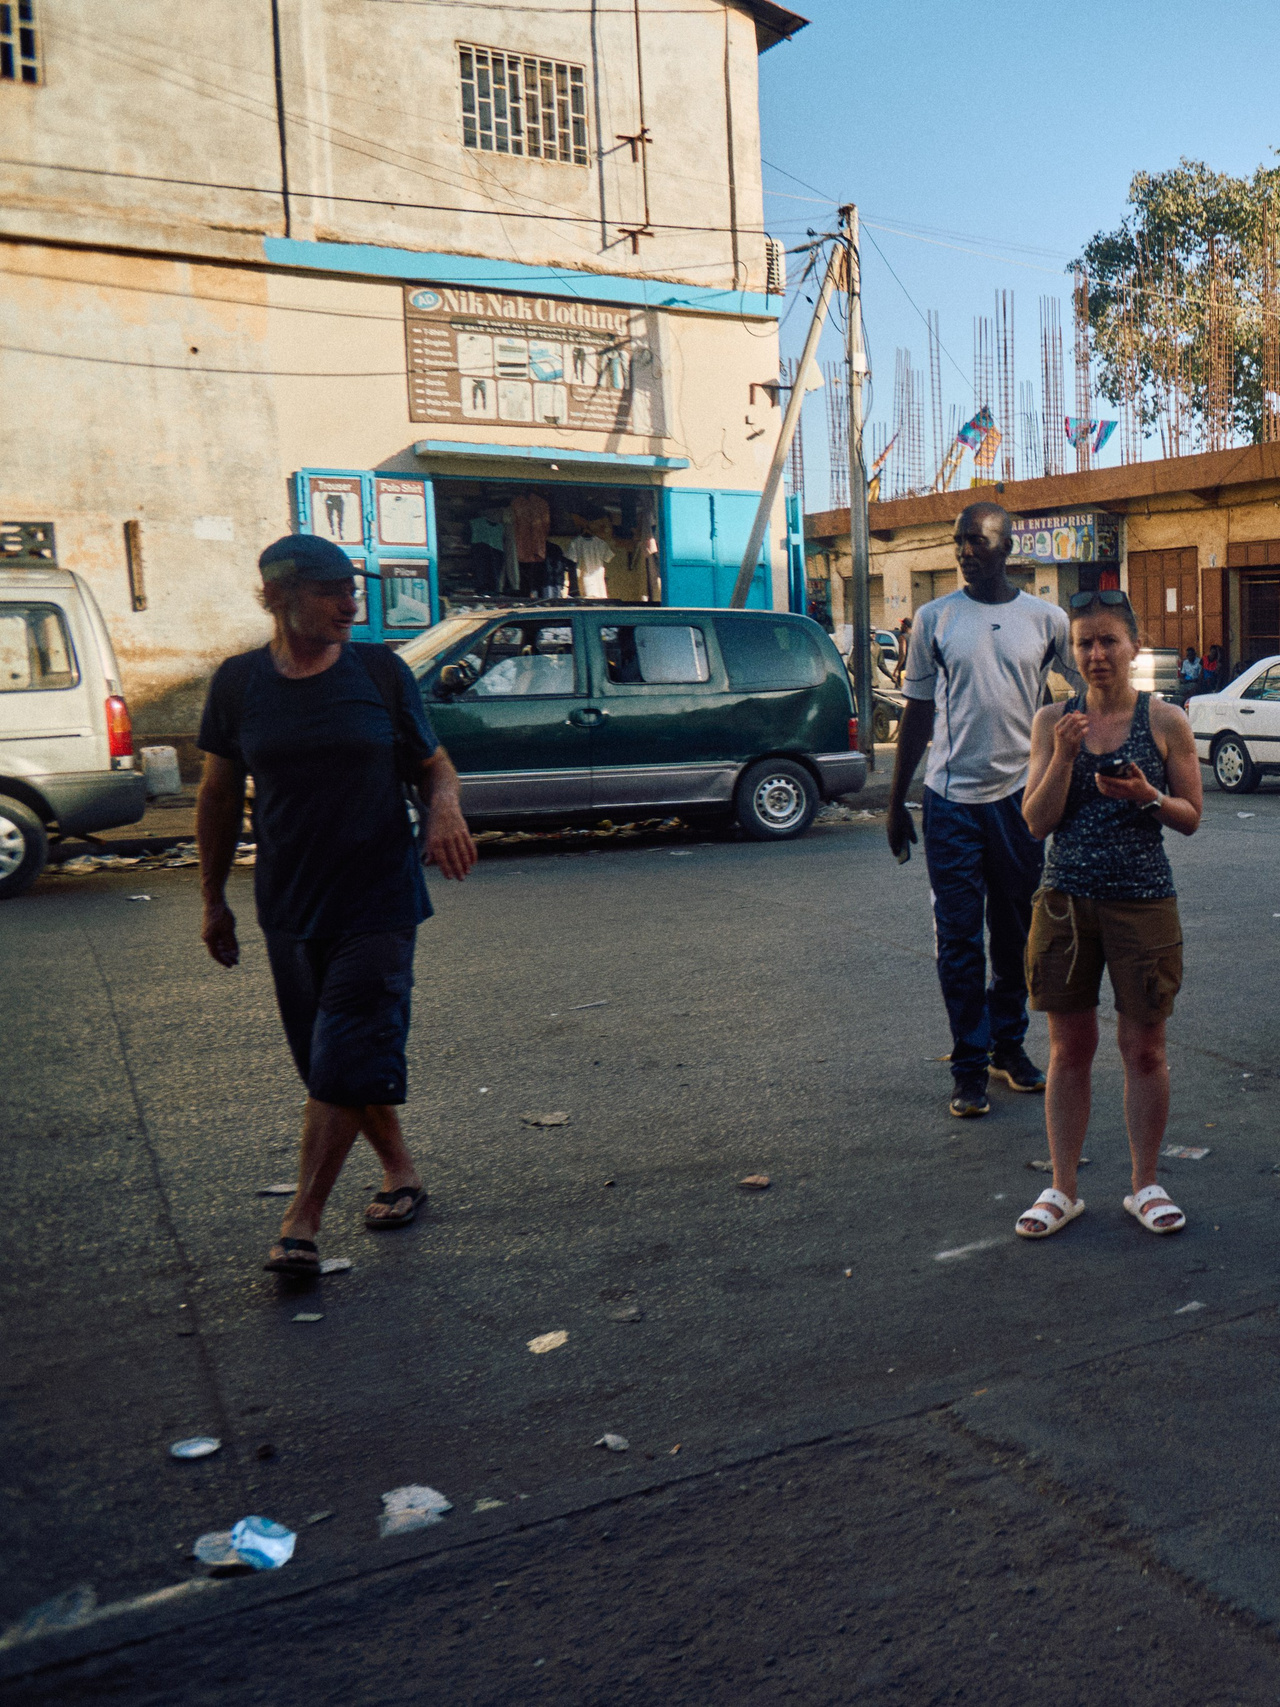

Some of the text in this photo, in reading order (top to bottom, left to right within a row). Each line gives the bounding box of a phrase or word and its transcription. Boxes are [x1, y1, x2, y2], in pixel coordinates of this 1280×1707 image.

[442, 288, 629, 336] Nik Nak Clothing
[380, 482, 422, 494] Polo Shirt
[1012, 520, 1025, 531] AH
[1028, 514, 1094, 530] ENTERPRISE
